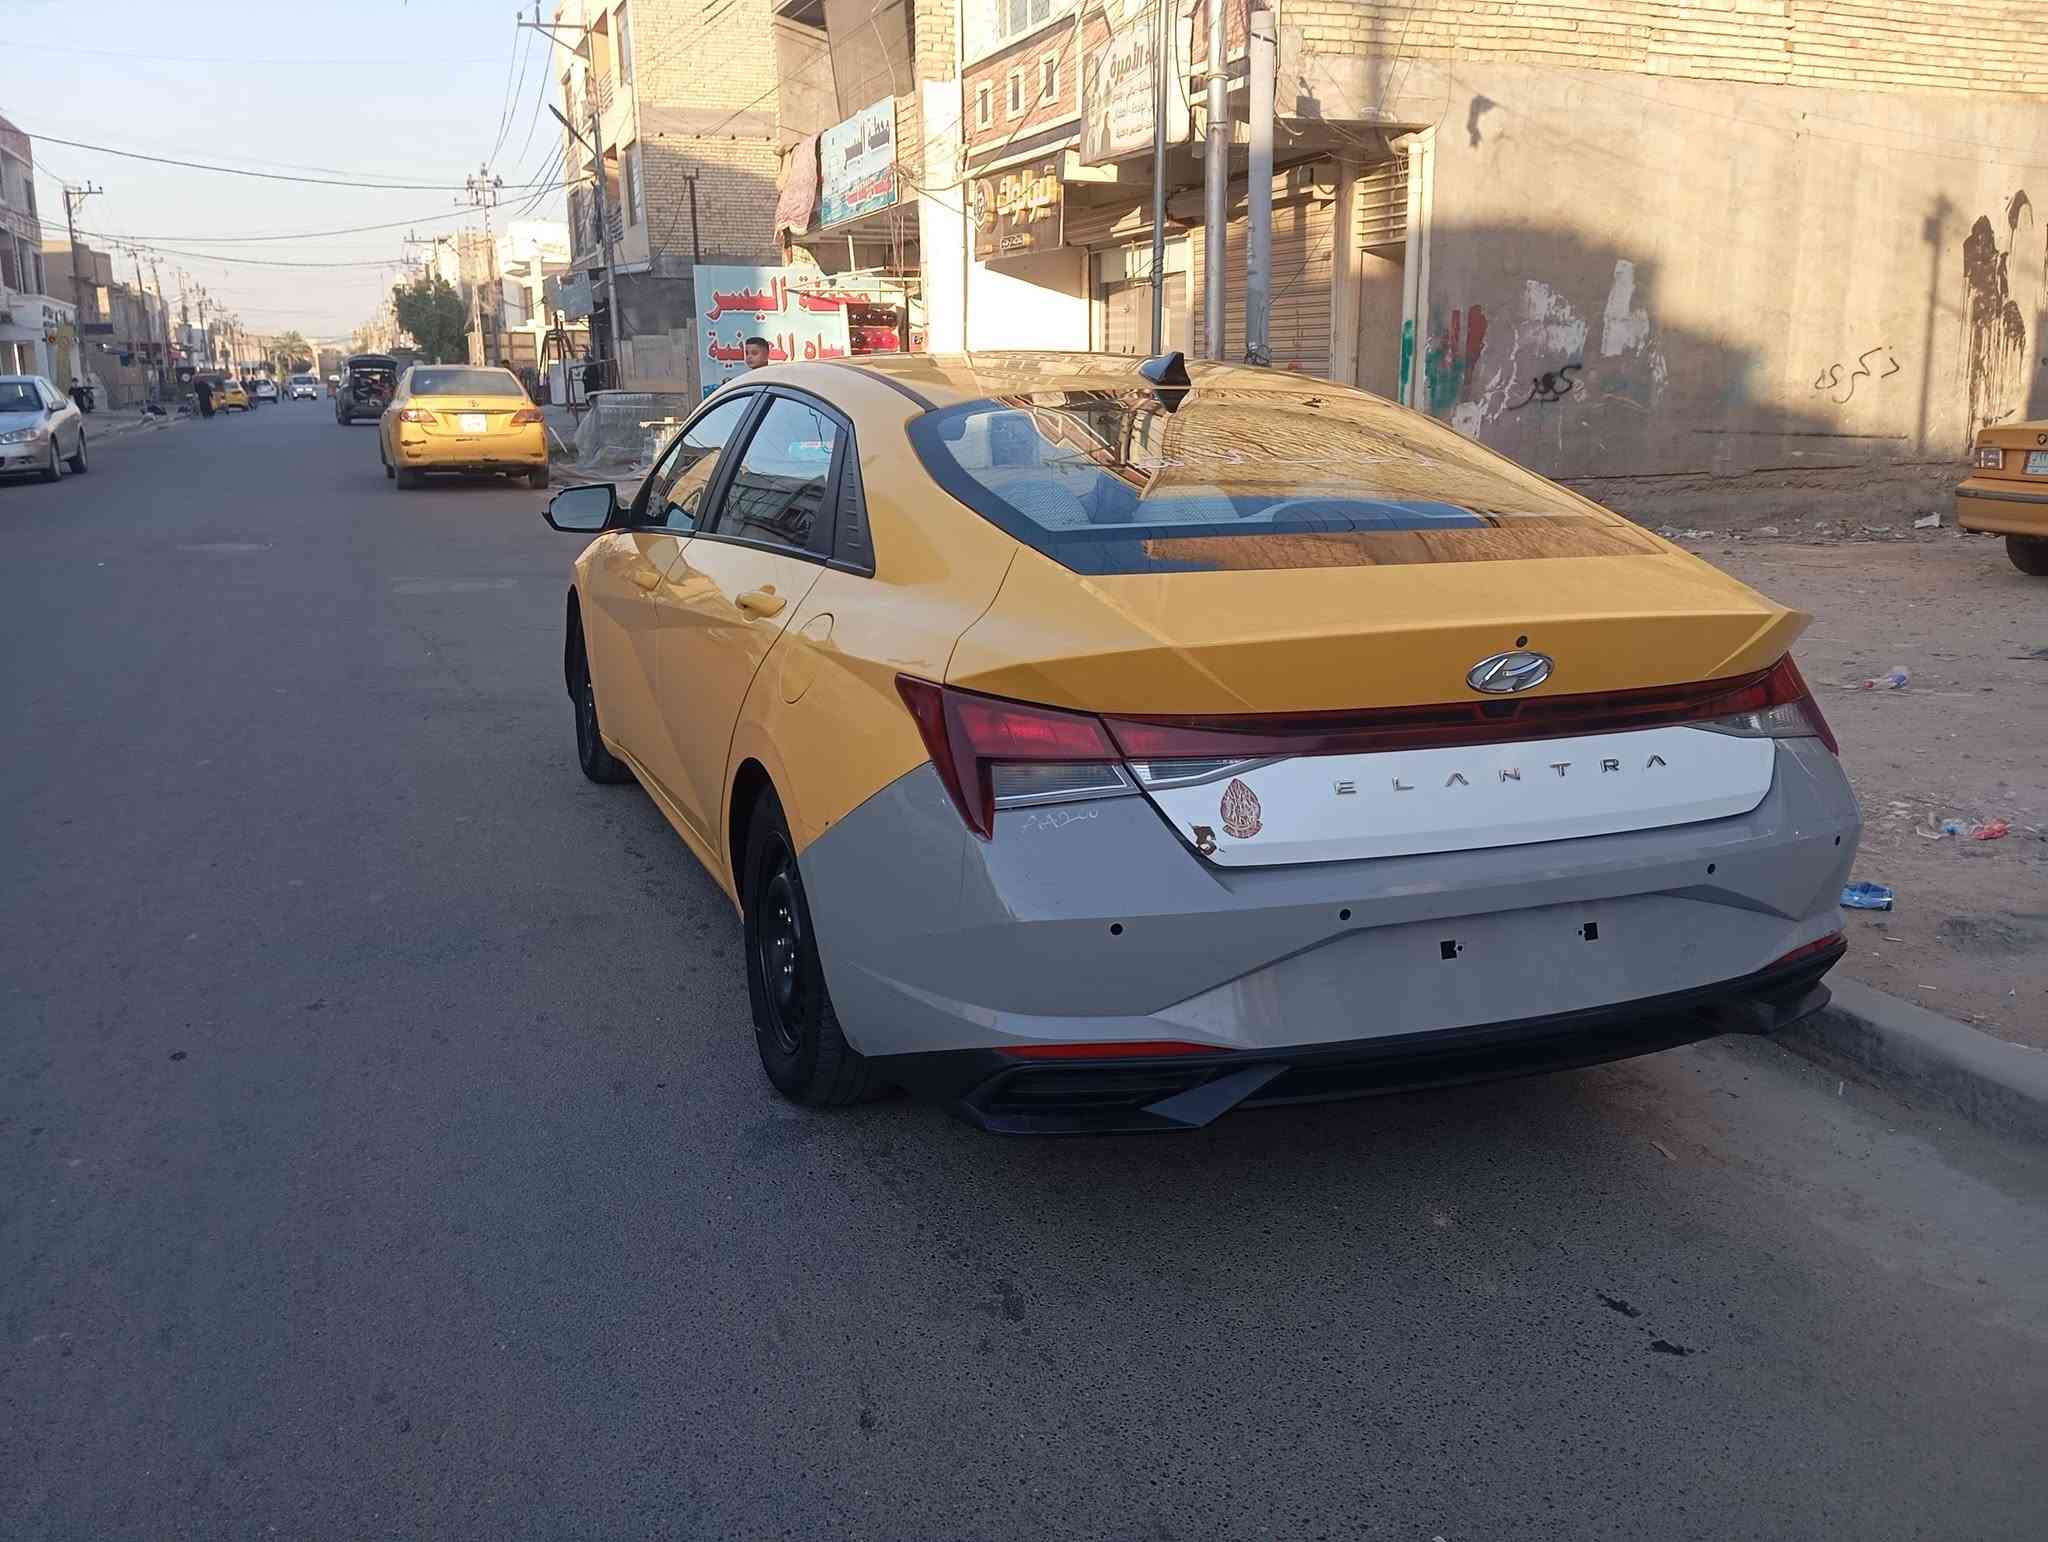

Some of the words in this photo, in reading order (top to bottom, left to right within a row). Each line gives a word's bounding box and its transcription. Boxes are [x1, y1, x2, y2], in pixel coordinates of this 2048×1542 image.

[706, 275, 788, 321] اليسر
[798, 275, 872, 312] محطة
[707, 330, 796, 368] المعنية
[1335, 753, 1666, 796] ELANTRA
